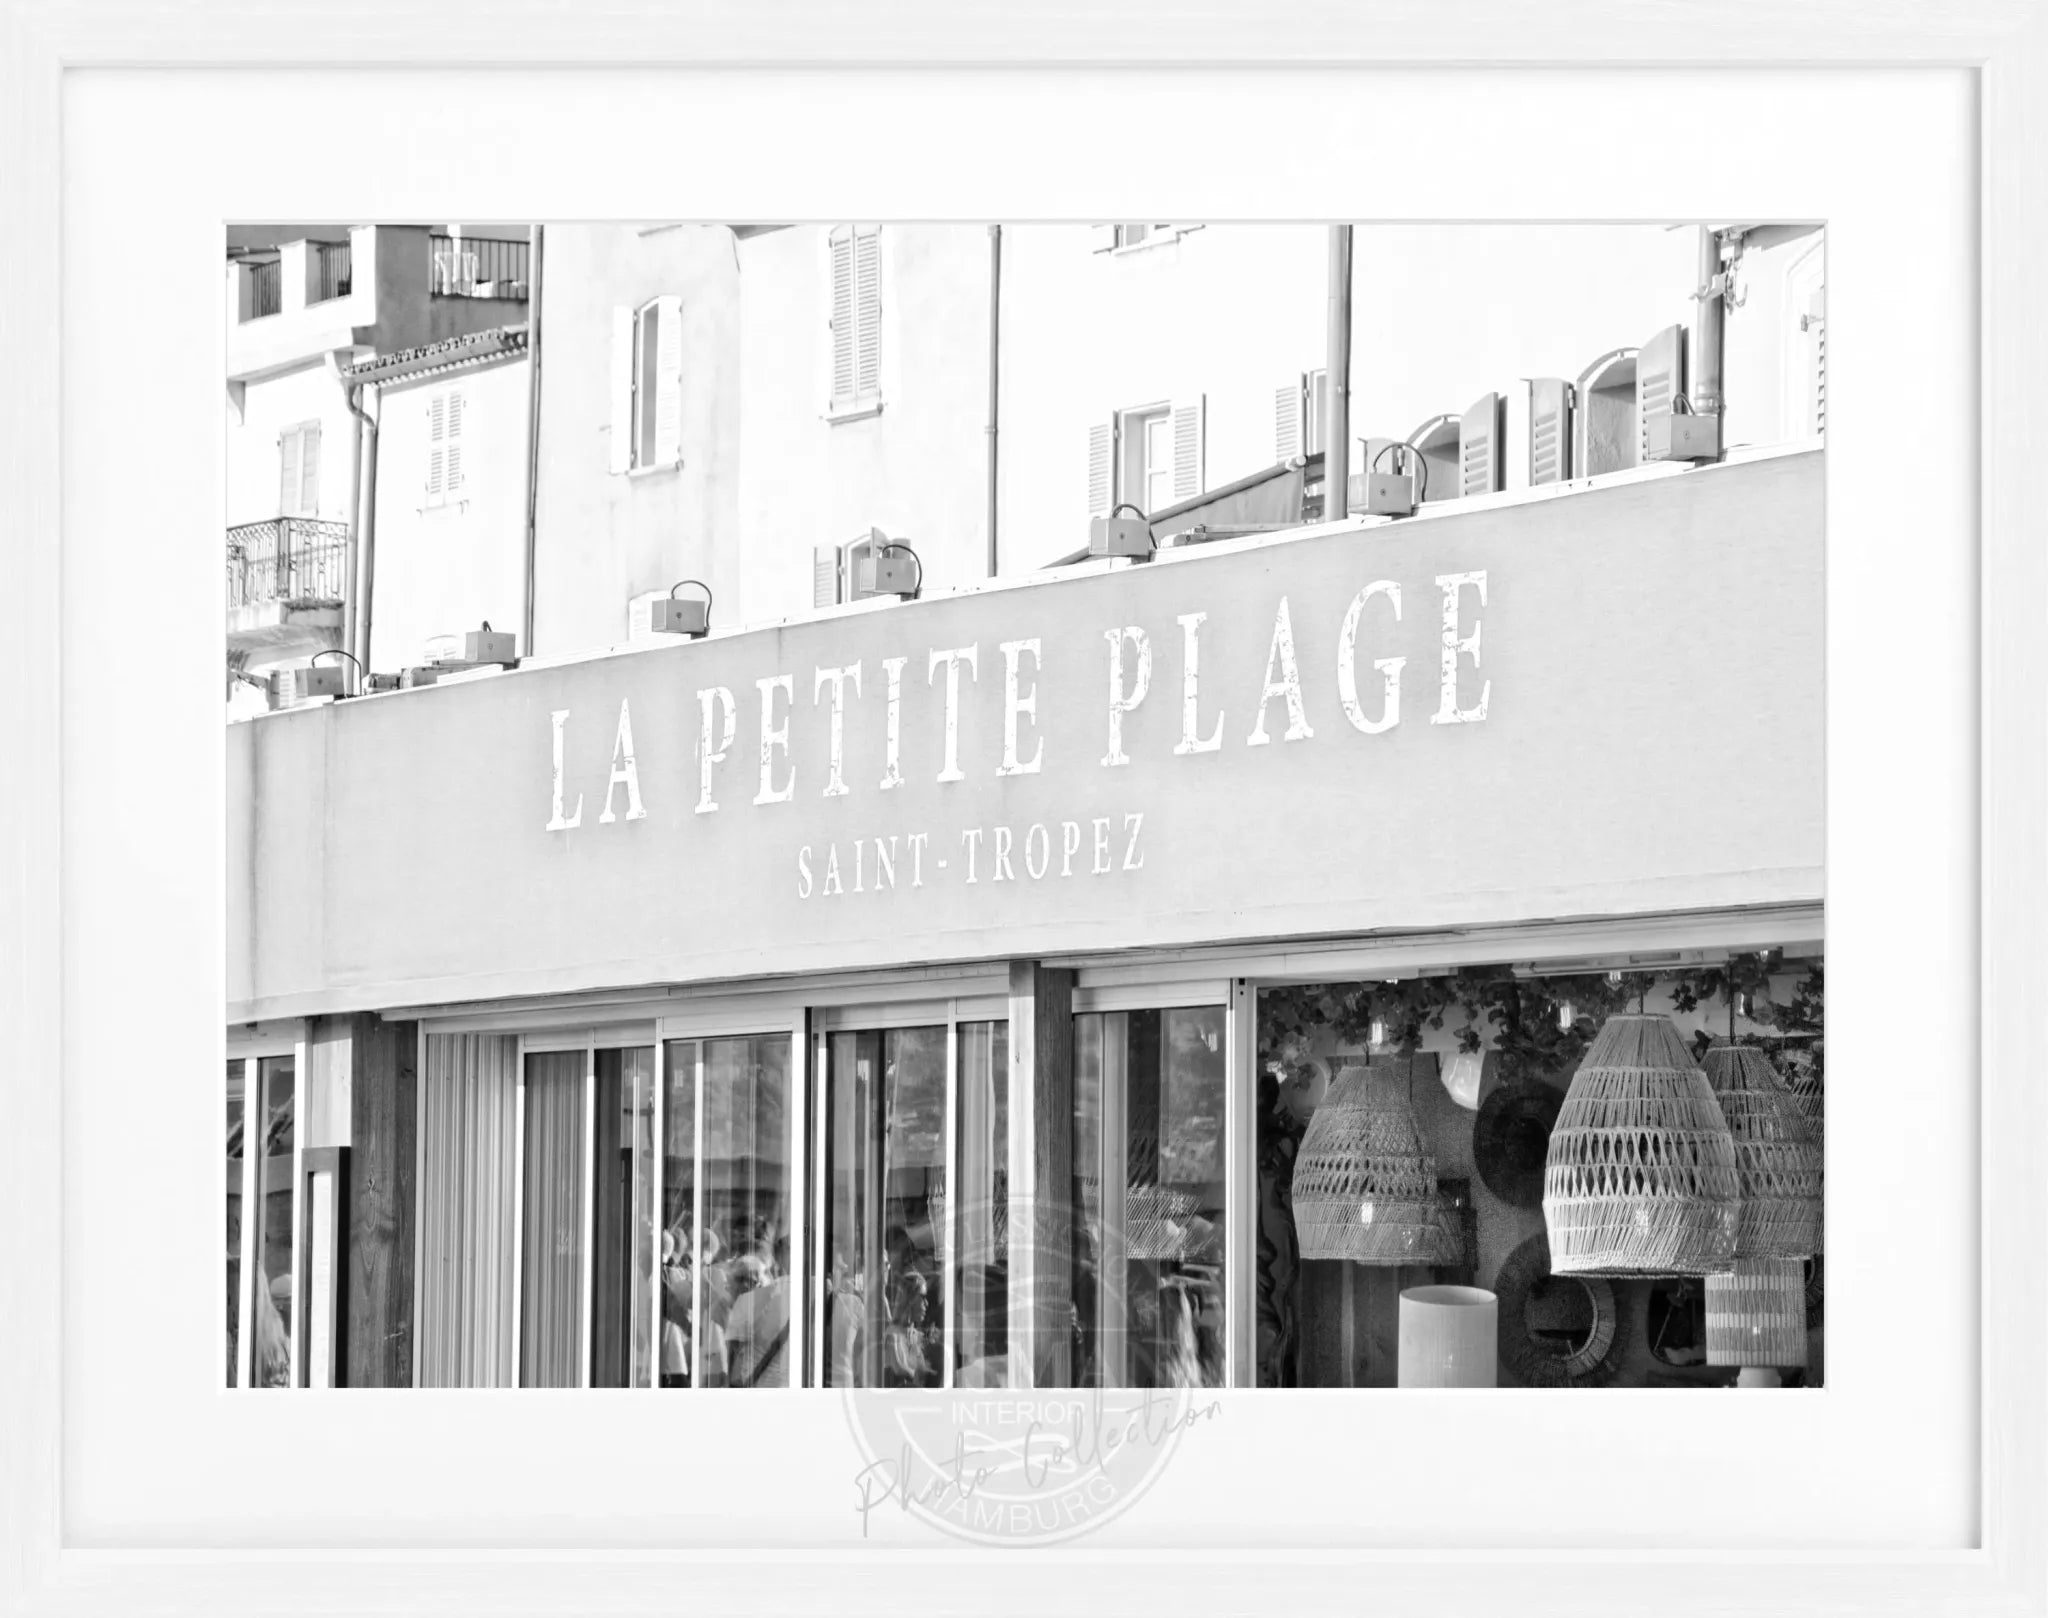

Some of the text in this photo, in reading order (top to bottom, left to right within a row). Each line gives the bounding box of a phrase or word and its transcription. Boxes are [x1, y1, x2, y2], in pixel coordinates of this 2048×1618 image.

[547, 570, 1491, 831] LA PETITE PLAGE
[798, 813, 1145, 899] SAINT-TROPEZ
